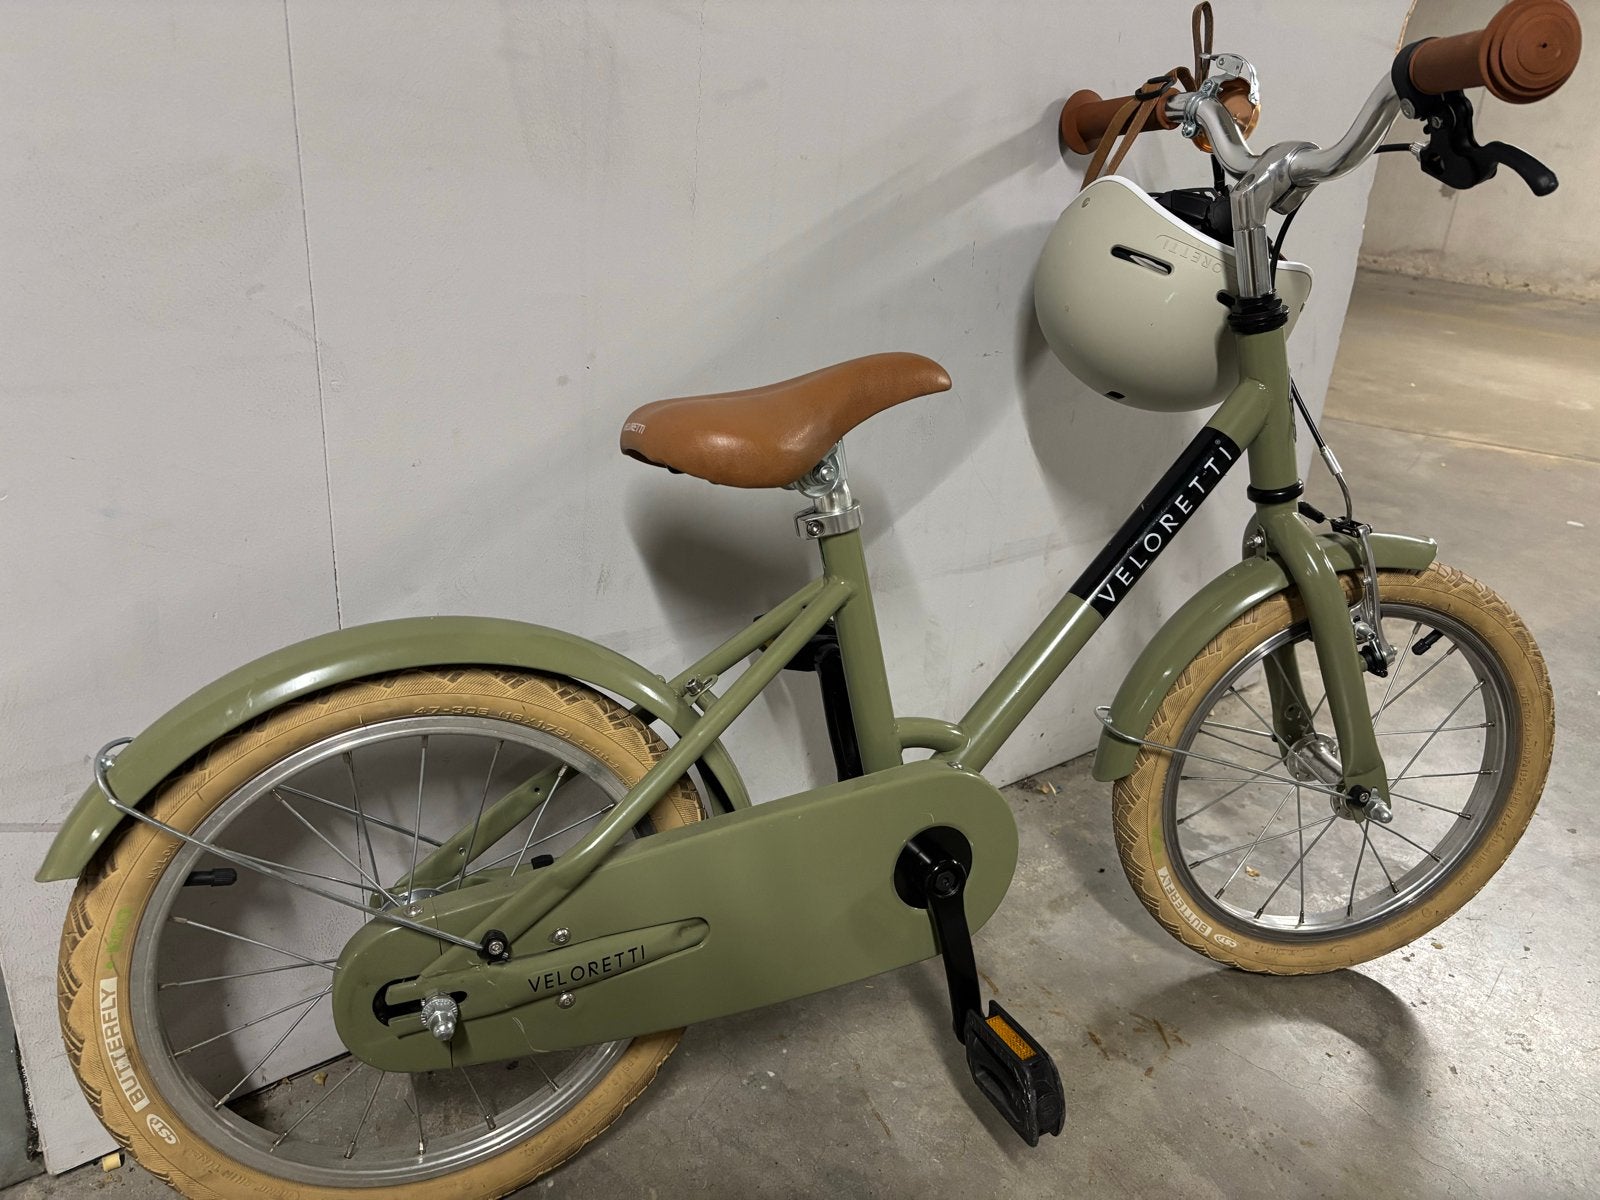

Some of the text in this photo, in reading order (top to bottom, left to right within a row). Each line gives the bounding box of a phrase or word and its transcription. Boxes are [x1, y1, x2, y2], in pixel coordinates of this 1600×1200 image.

[1161, 239, 1222, 273] ORETTI
[1097, 446, 1232, 603] VELORETTI
[1159, 871, 1209, 934] BUTTERFLY
[528, 945, 645, 992] VELORETTI
[101, 987, 147, 1107] BUTTERFLY
